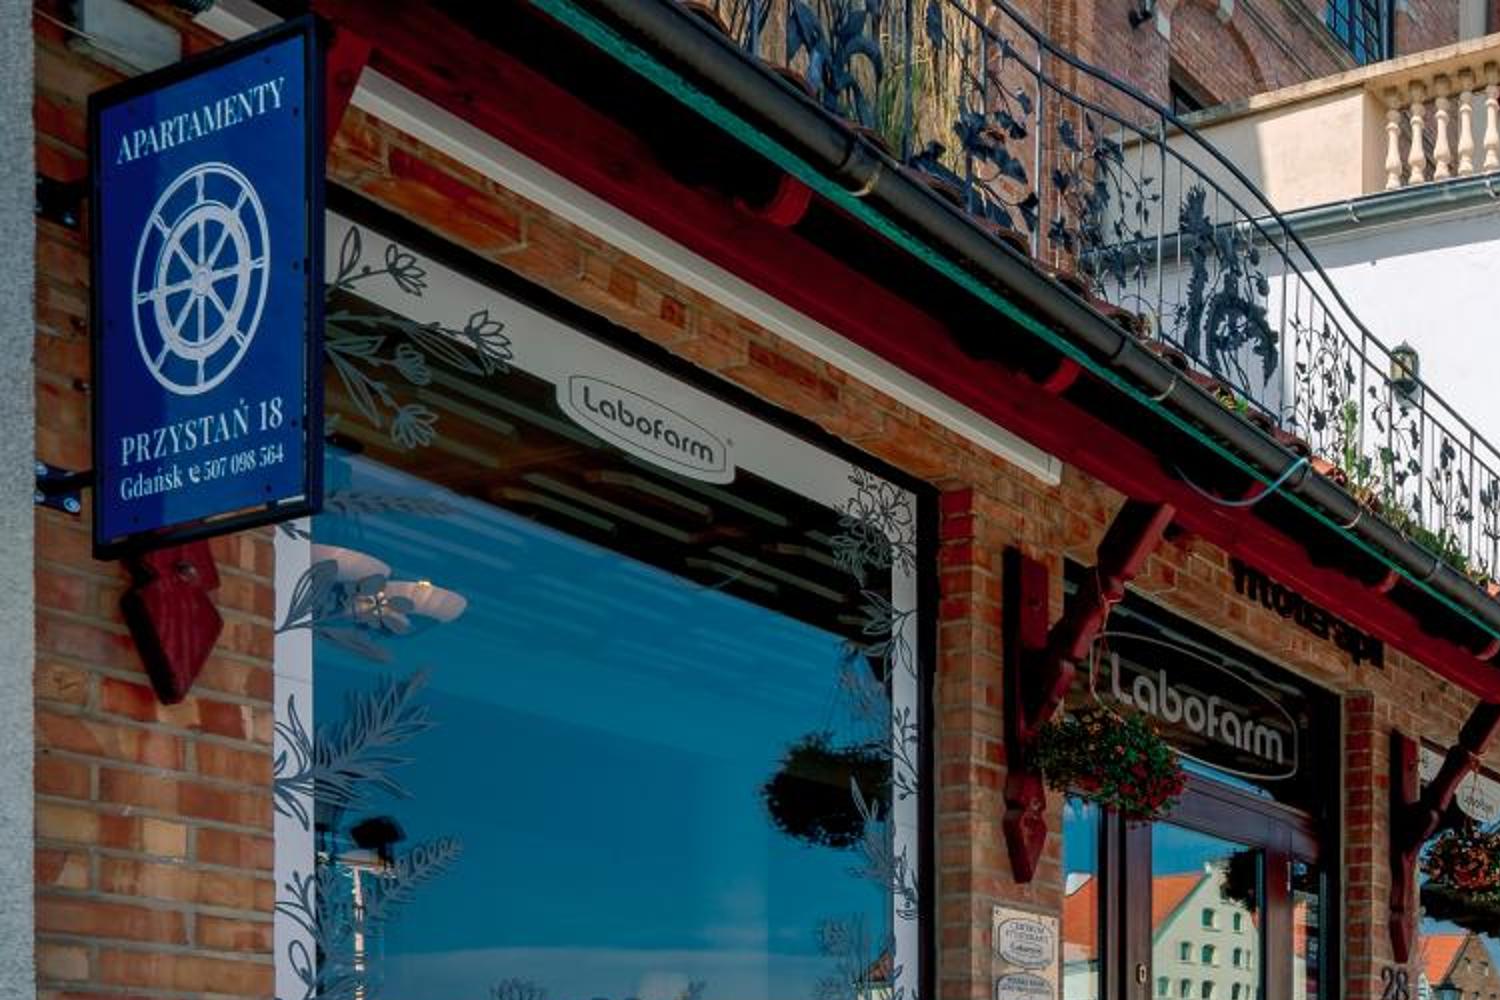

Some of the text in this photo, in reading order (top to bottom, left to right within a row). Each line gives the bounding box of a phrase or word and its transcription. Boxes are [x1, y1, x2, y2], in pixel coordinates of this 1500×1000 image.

[116, 76, 285, 165] APARTAMENTY
[121, 396, 284, 467] PRZYSTAŃ 18
[583, 385, 714, 464] Labofarm
[120, 464, 183, 501] Gdańsk
[204, 458, 228, 481] 507
[231, 450, 257, 475] 098
[1111, 651, 1284, 765] Labofarm
